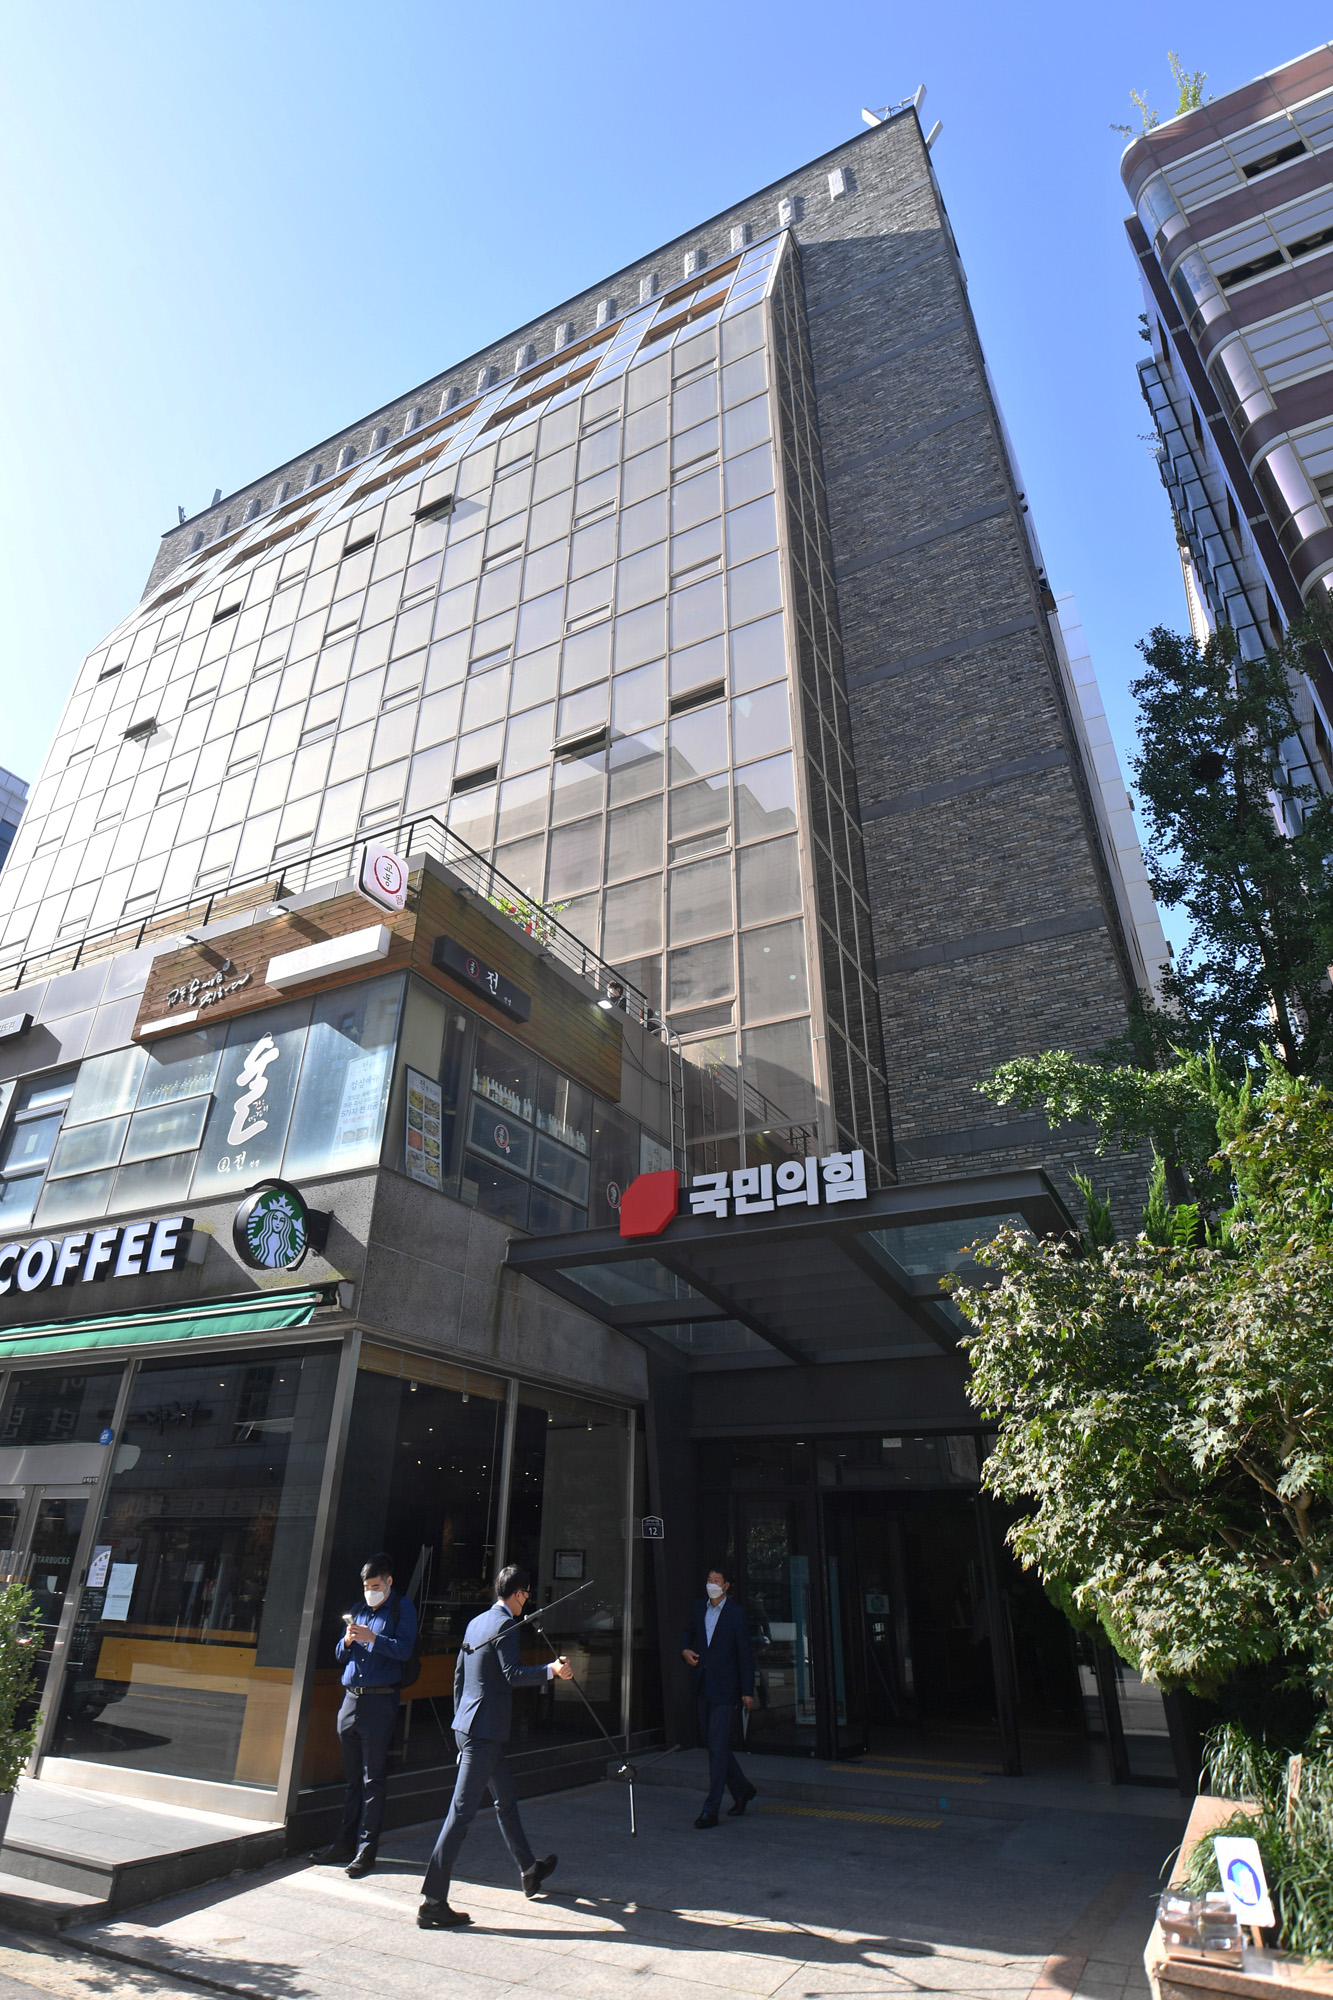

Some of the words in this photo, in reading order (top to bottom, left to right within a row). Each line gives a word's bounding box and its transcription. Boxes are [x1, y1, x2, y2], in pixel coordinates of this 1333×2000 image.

[485, 971, 499, 995] 전
[690, 1150, 867, 1218] 국민의힘
[0, 1216, 184, 1296] COFFEE
[648, 1527, 658, 1536] 12
[34, 1555, 71, 1565] STARBUCKS
